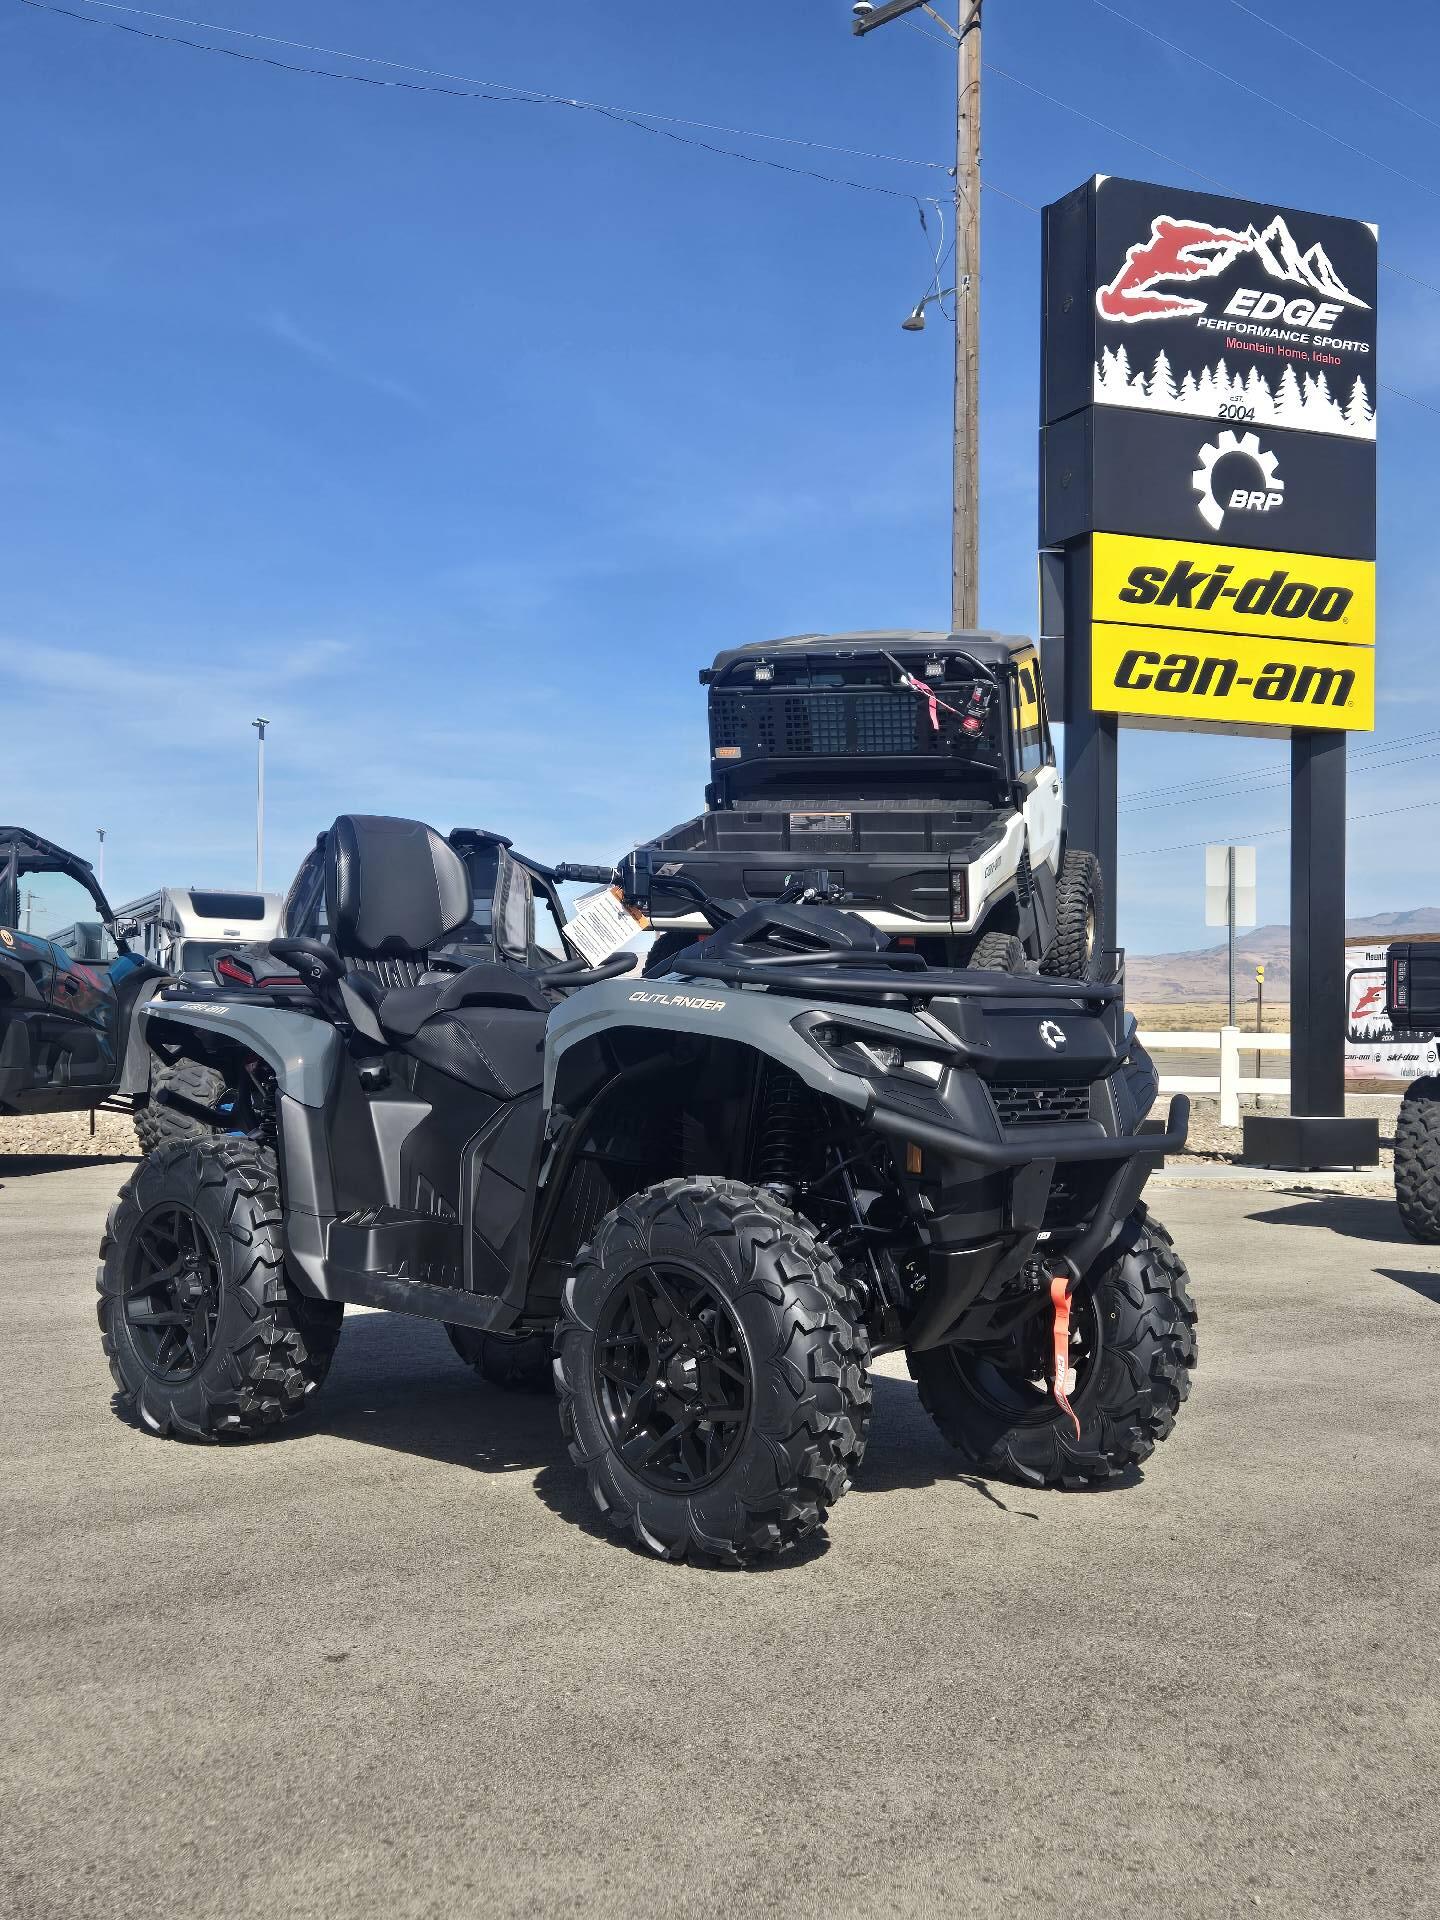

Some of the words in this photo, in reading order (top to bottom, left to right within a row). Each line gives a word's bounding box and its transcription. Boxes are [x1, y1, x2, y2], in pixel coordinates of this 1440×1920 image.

[1223, 287, 1345, 331] EDGE
[1197, 317, 1311, 344] PERFORMANCE
[1312, 335, 1370, 353] SPORTS
[1226, 337, 1274, 355] Mountain
[1277, 345, 1310, 362] Home,
[1312, 351, 1341, 365] Idaho
[1218, 403, 1256, 420] 2004
[1228, 488, 1284, 511] BRP
[1118, 560, 1354, 623] ski-doo
[1113, 649, 1356, 706] can-am
[628, 991, 727, 1012] OUTLANDER
